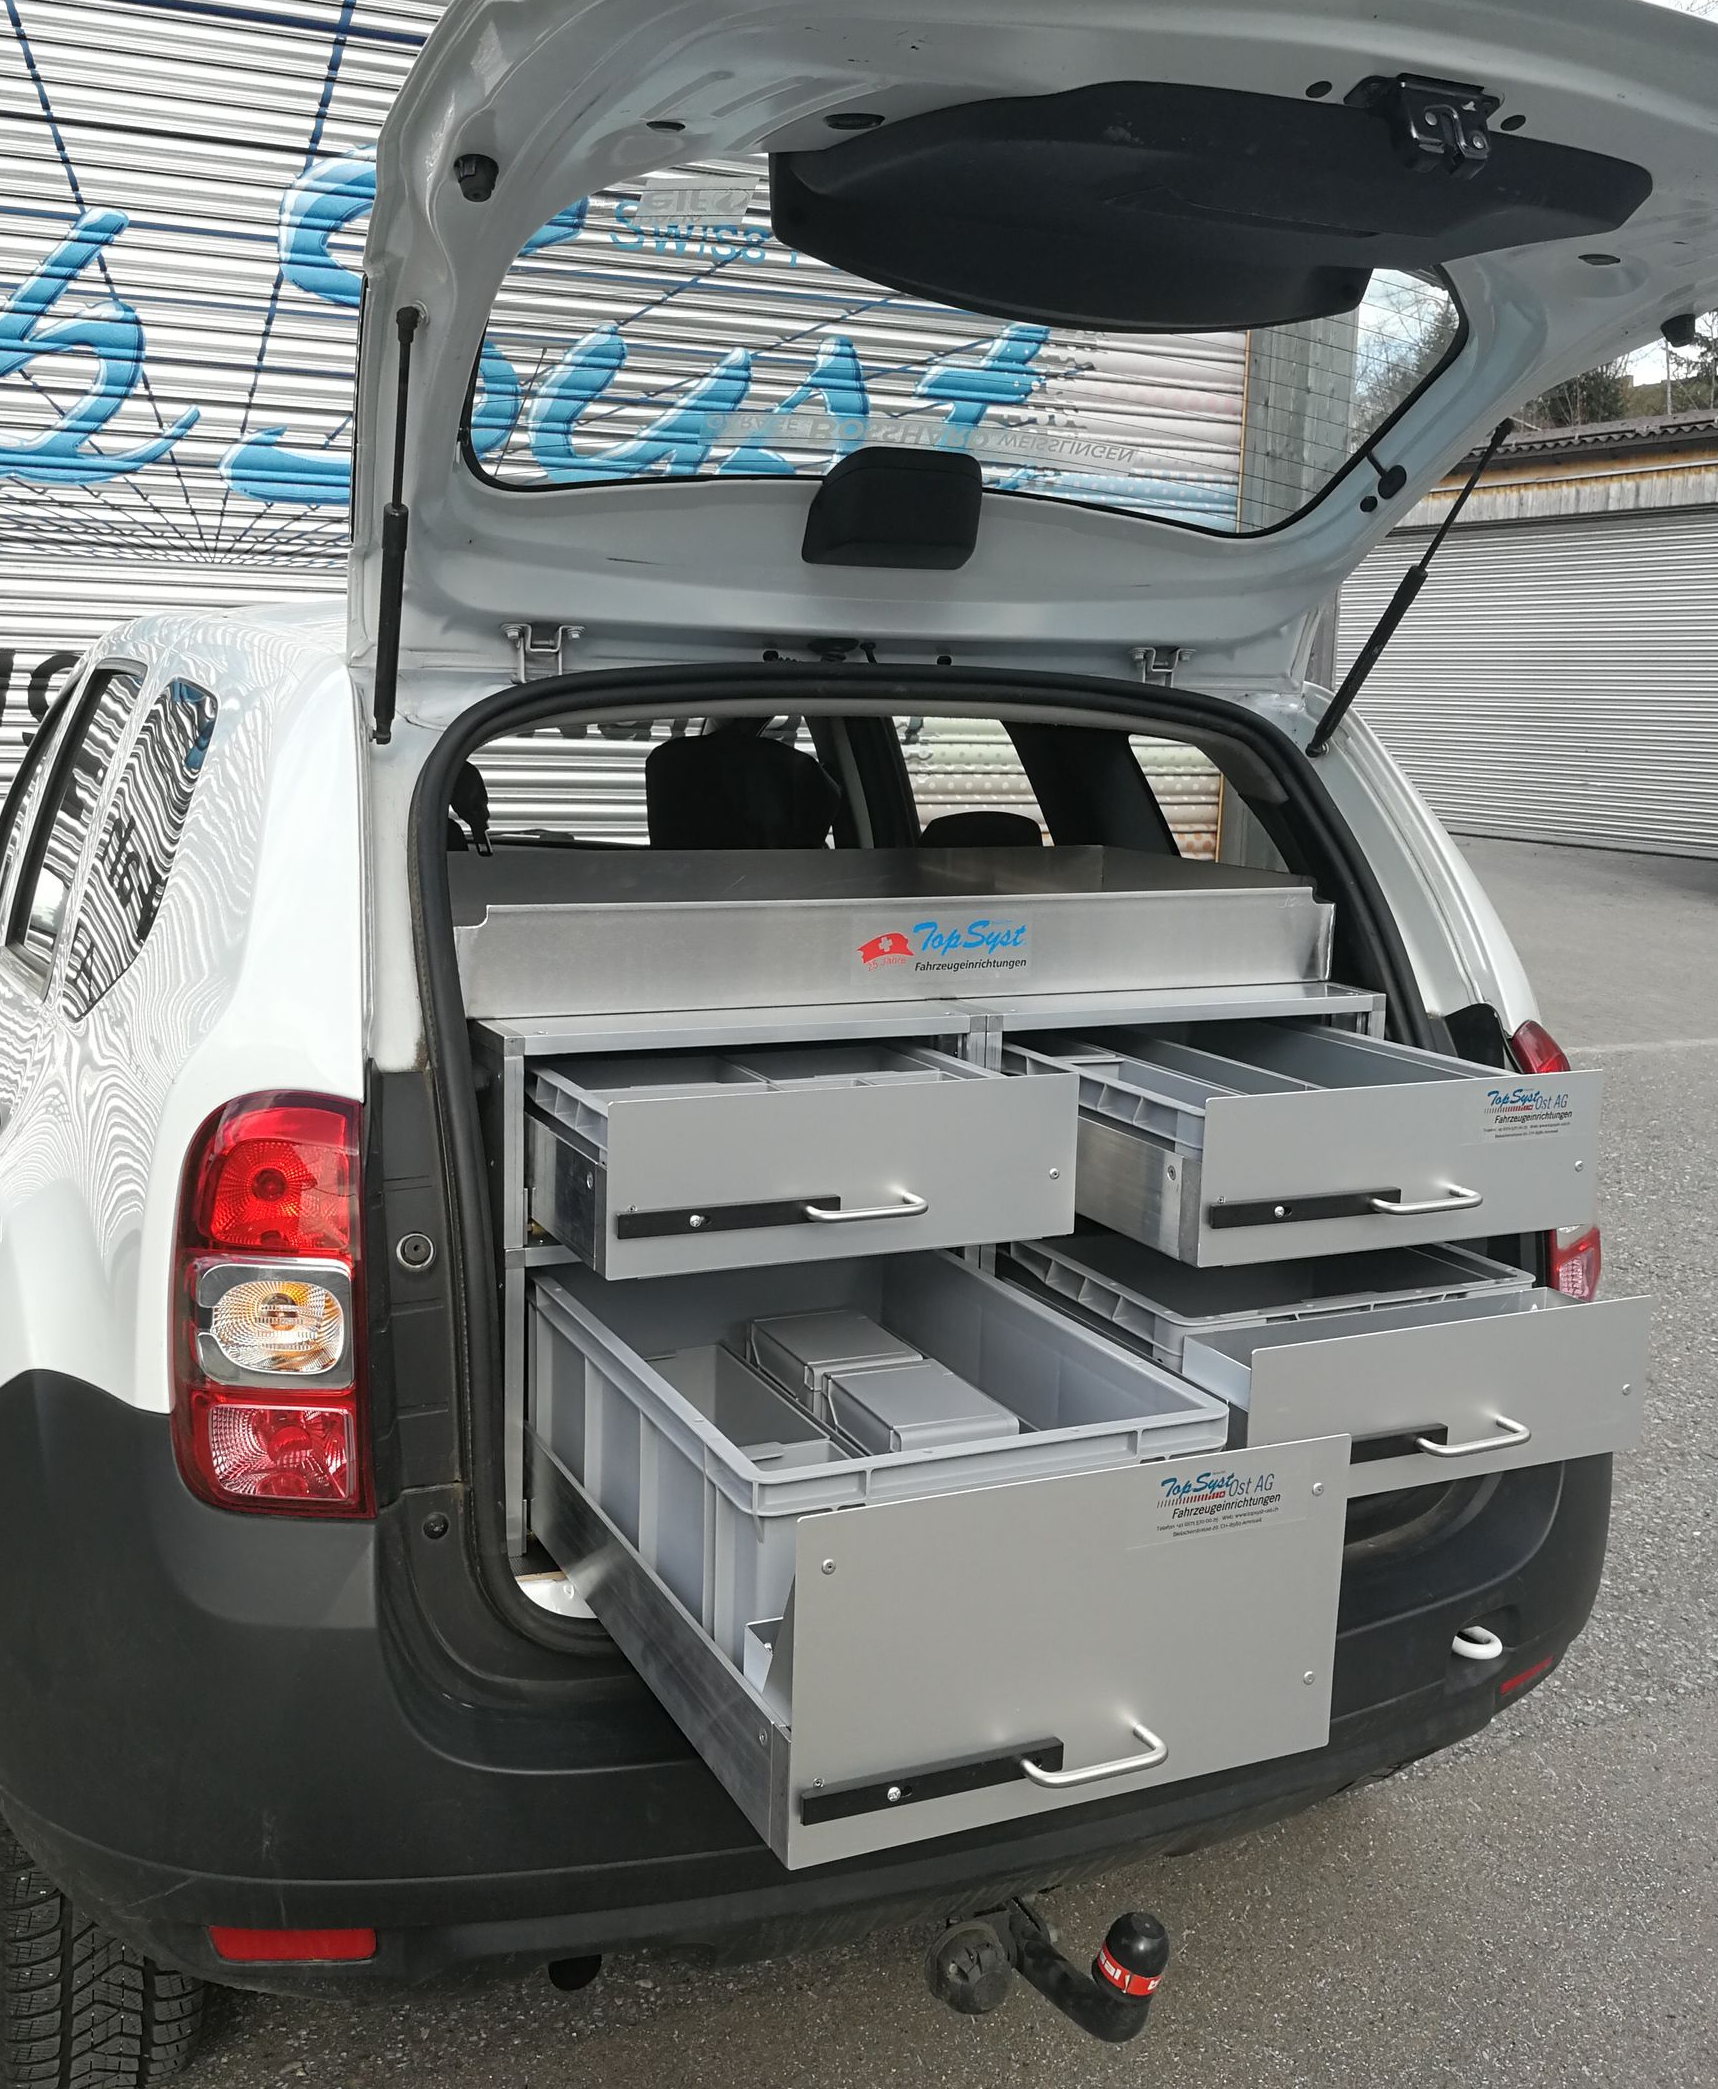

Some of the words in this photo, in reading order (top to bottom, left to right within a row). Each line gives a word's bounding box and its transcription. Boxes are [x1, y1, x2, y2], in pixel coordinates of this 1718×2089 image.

[914, 958, 1027, 972] Fahrzeugeinrichtungen
[1535, 1095, 1552, 1110] Ost
[1554, 1093, 1569, 1109] AG
[1494, 1111, 1573, 1124] Fahrzeugeinrichtungen
[1228, 1478, 1251, 1497] Ost
[1253, 1473, 1275, 1493] AG
[1171, 1493, 1282, 1519] Fahrzeugeinrichtungen
